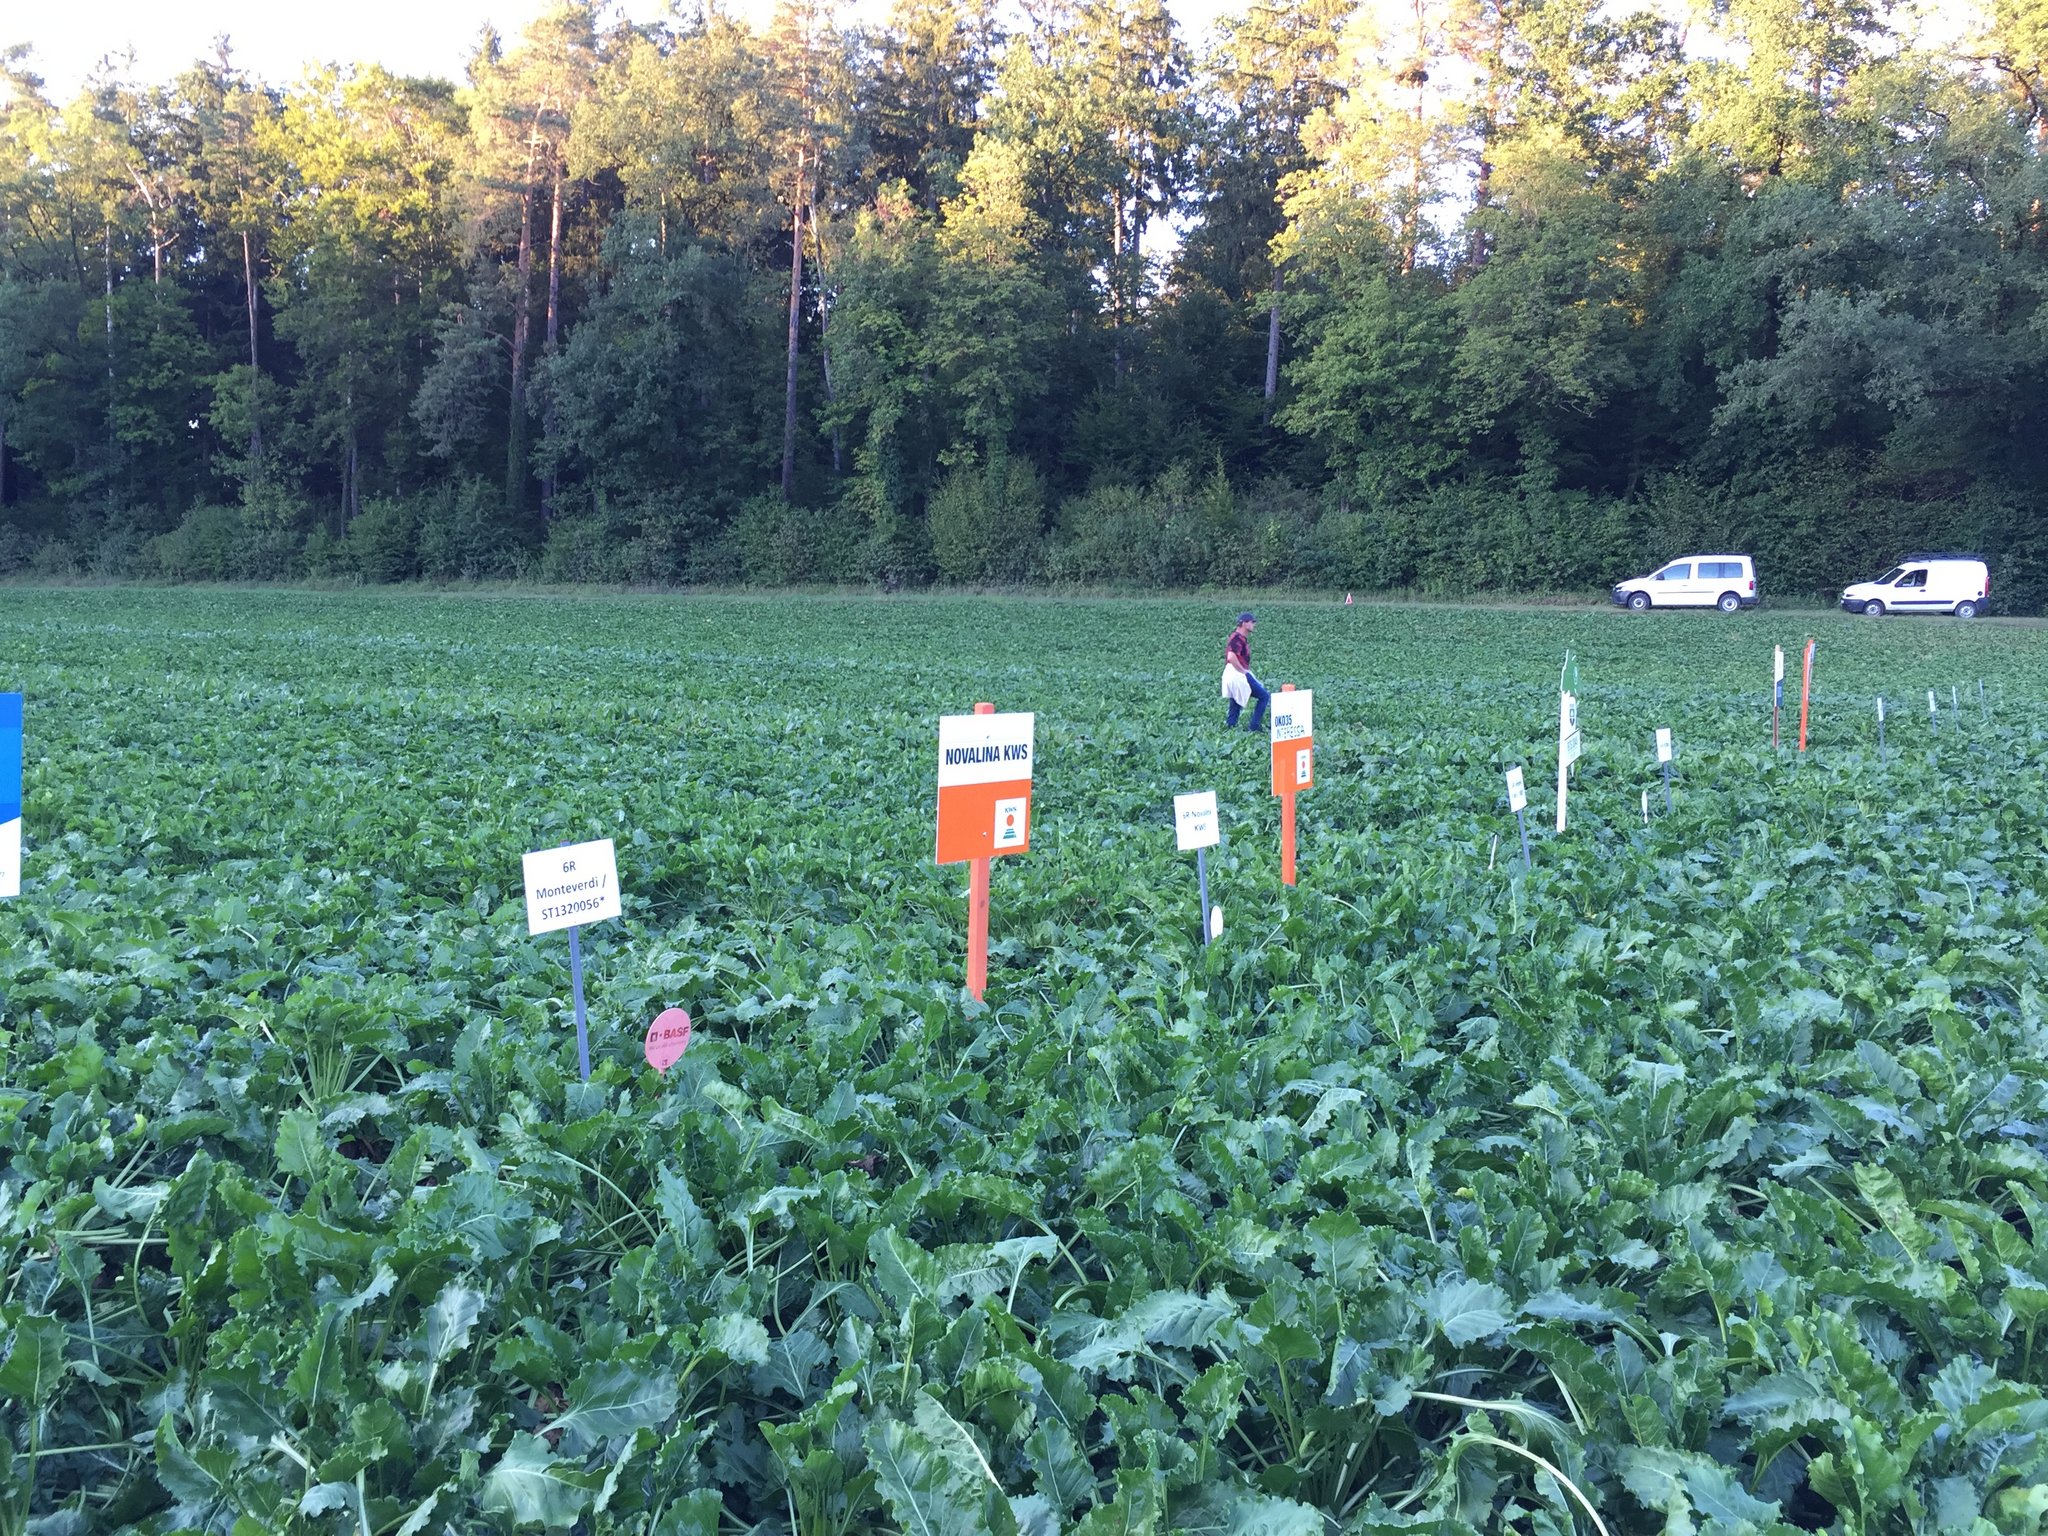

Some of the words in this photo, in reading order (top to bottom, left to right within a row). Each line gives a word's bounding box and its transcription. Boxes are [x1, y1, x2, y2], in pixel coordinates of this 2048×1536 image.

[945, 745, 1001, 765] NOVALINA
[1003, 743, 1028, 761] KWS
[562, 860, 576, 873] 6R
[535, 876, 599, 899] Monteverdi
[601, 873, 608, 888] /
[664, 1026, 689, 1040] BASF
